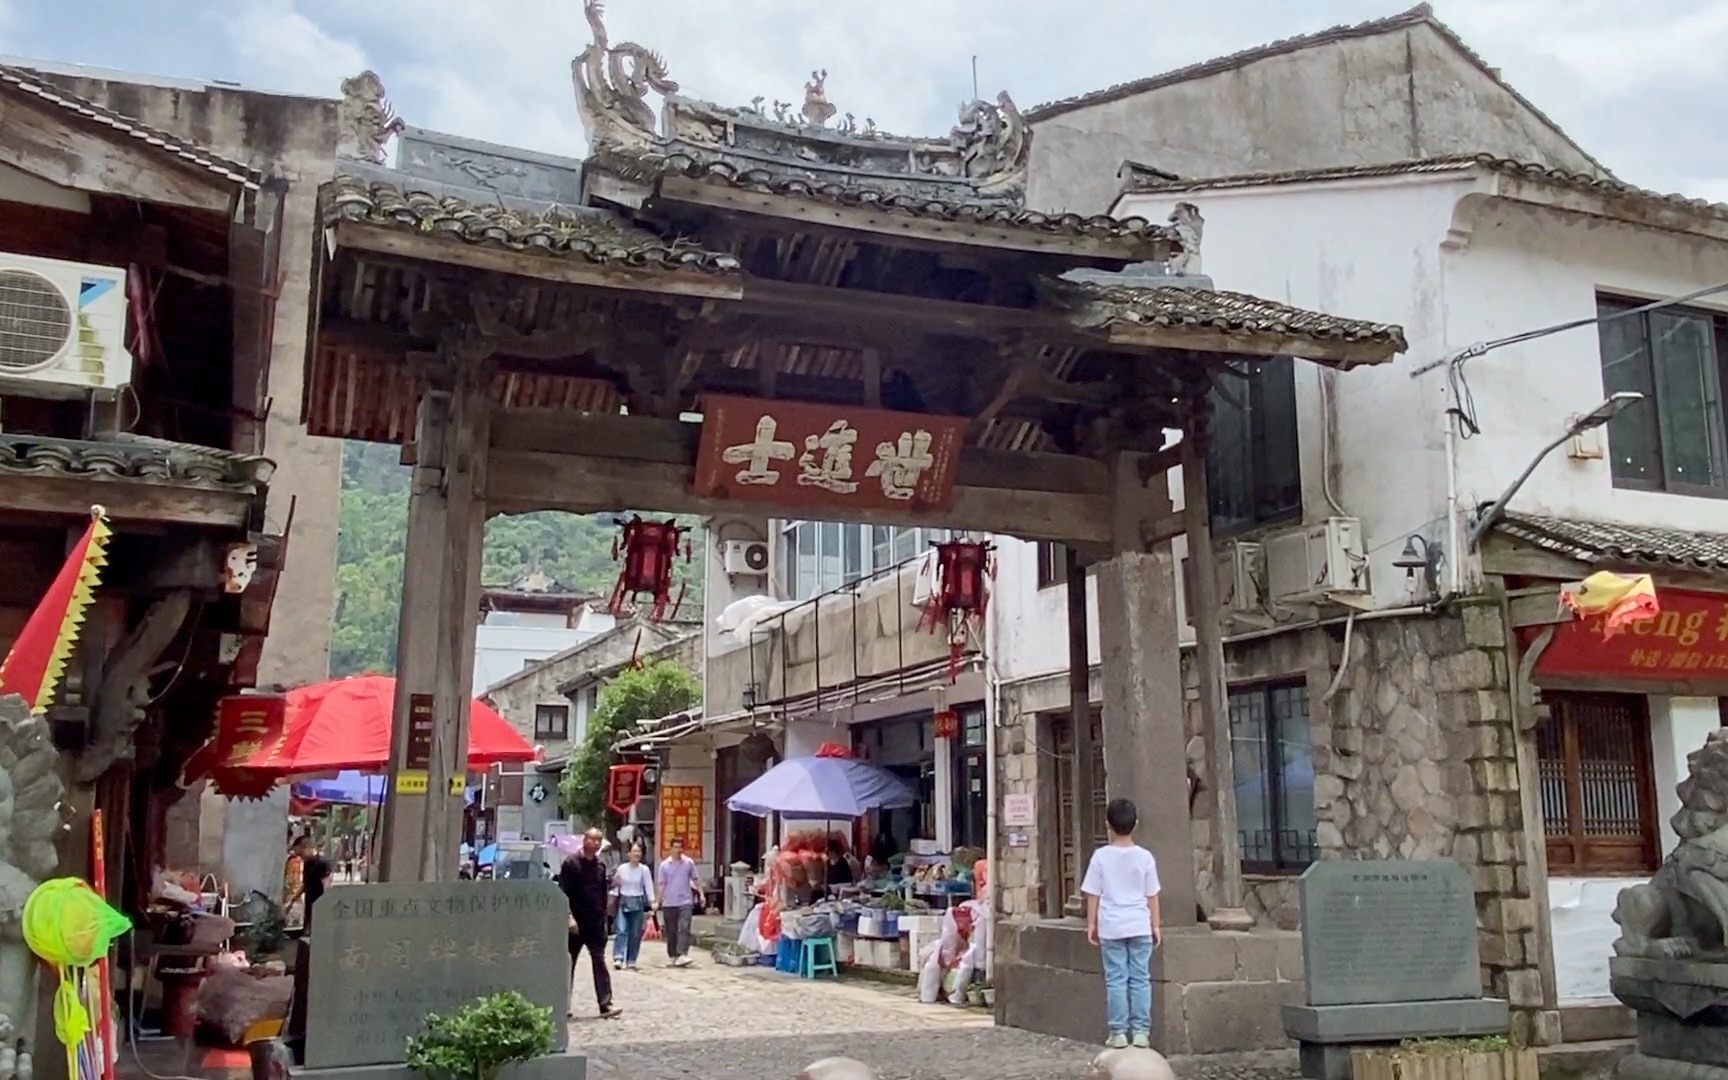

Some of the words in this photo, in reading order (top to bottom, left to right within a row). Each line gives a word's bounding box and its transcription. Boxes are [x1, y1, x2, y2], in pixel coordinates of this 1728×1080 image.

[332, 894, 552, 920] 全国重点文物保护单位
